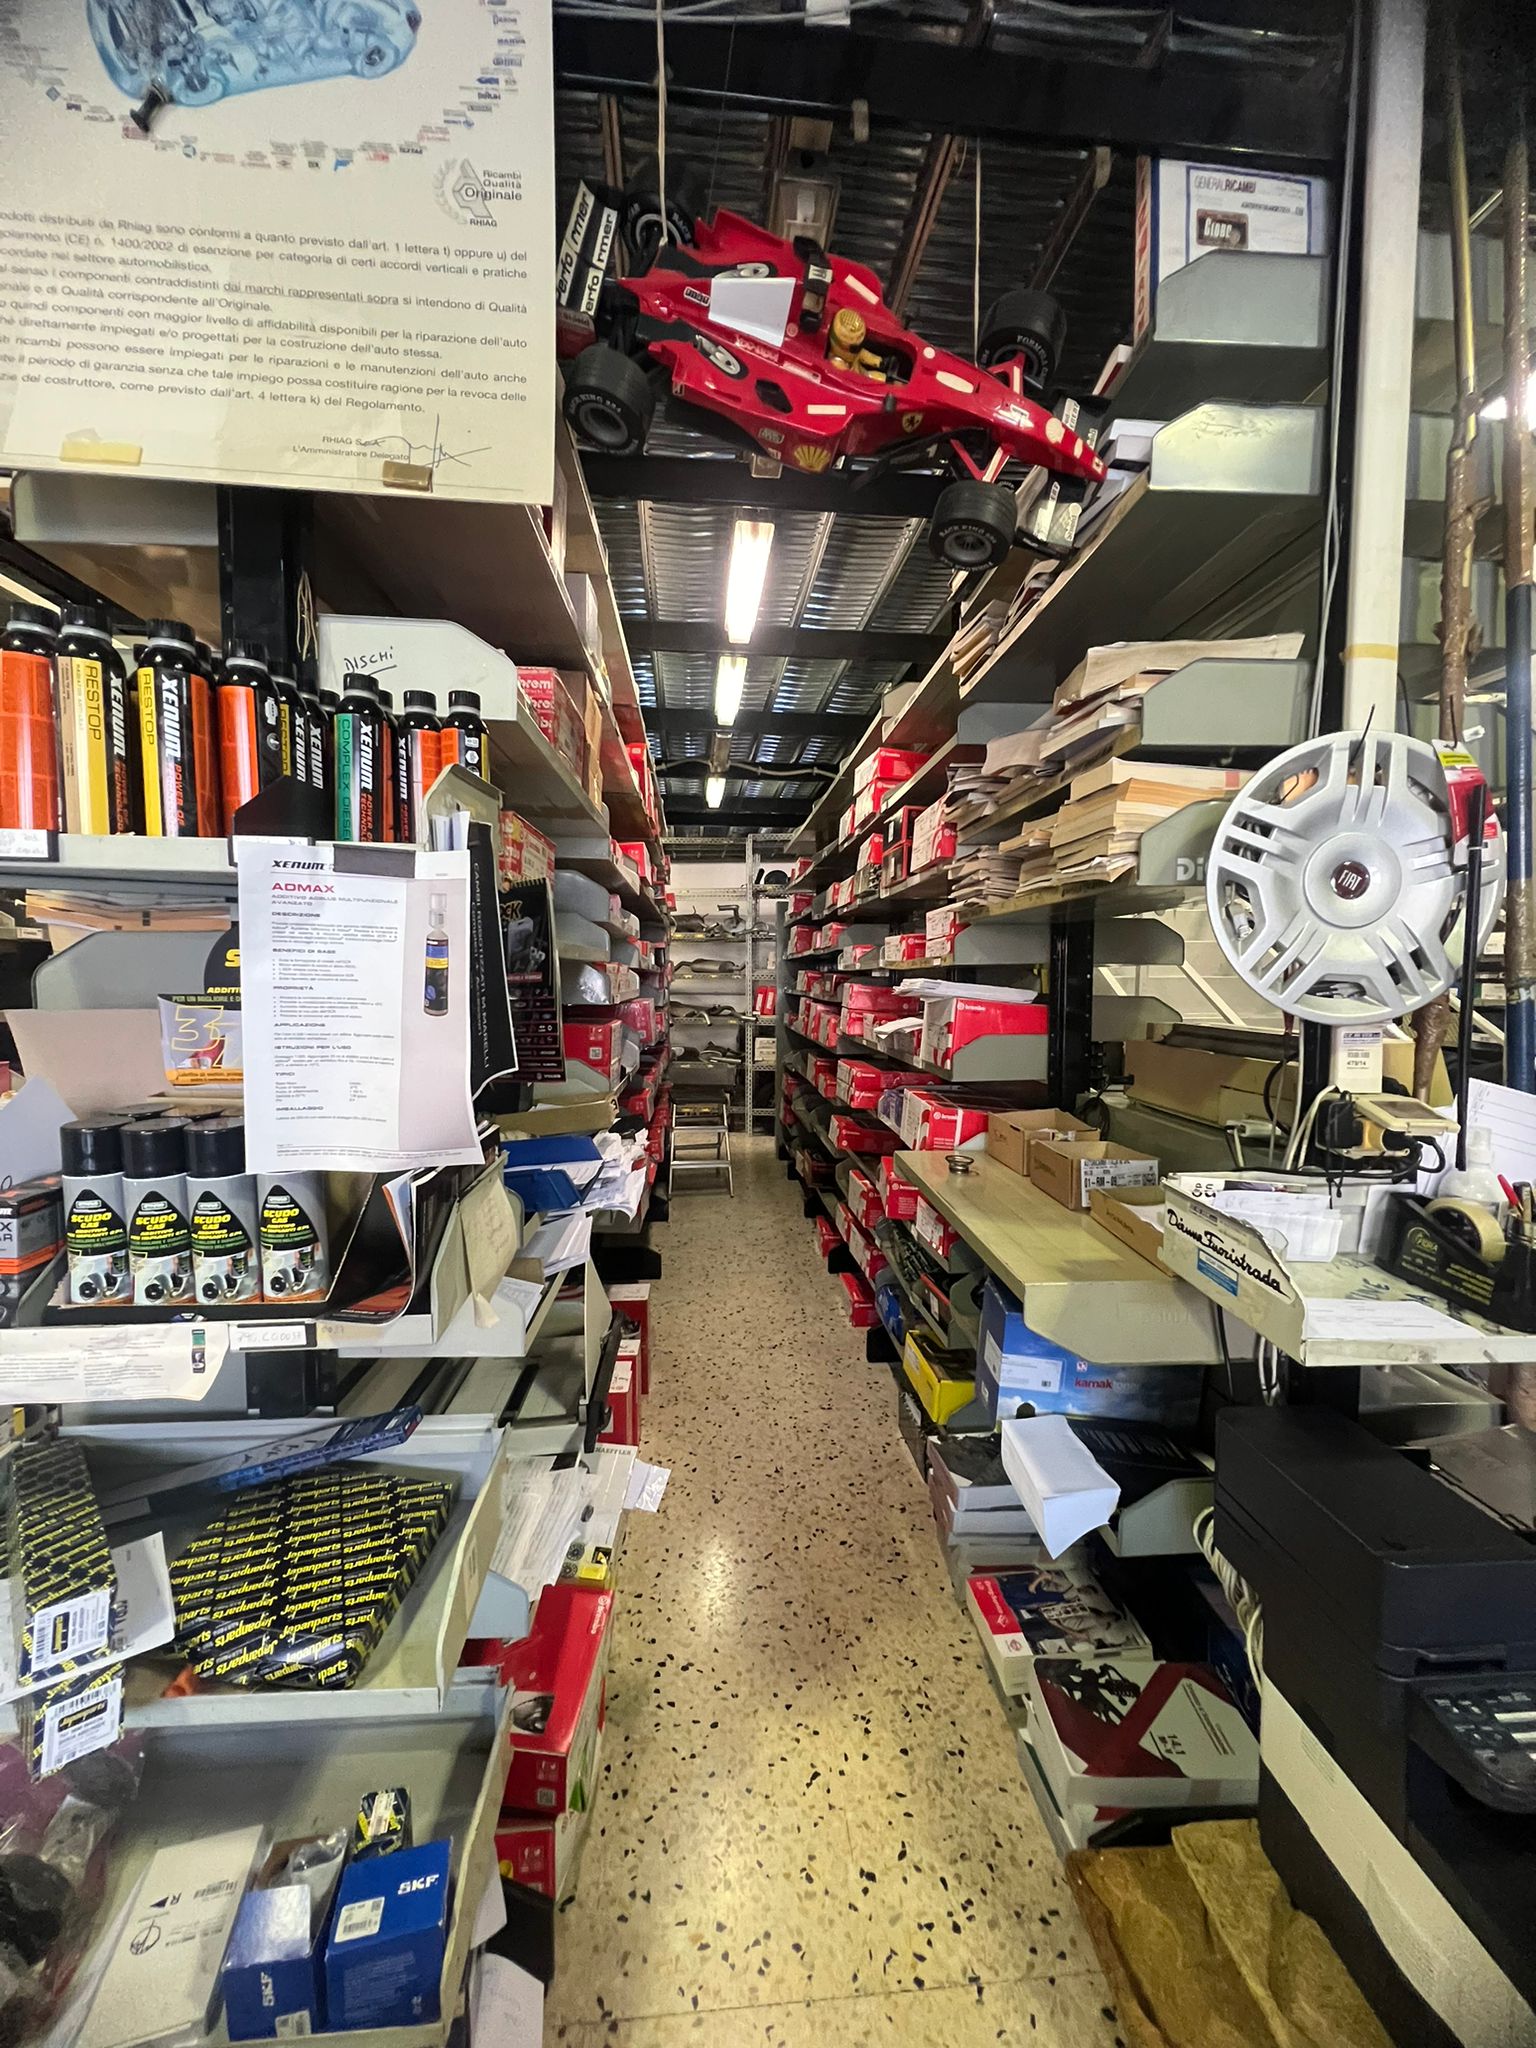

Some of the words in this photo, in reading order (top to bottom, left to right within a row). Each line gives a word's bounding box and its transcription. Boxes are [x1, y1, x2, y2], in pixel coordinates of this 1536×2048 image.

[483, 170, 521, 180] Ricambi
[483, 179, 521, 189] Qualità
[465, 187, 522, 201] Originale
[470, 218, 497, 227] RHIAG
[118, 220, 152, 235] Rhiag
[156, 226, 185, 235] sono
[190, 227, 240, 239] conformi
[256, 234, 295, 244] quanto
[300, 237, 344, 248] previsto
[348, 239, 389, 252] dall'art.
[405, 244, 440, 256] lettera
[455, 251, 493, 261] oppure
[74, 254, 116, 265] settore
[119, 257, 212, 272] automobilistico.
[111, 237, 174, 252] 1400/2002
[194, 247, 251, 259] esenzione
[279, 253, 332, 266] categoria
[380, 262, 422, 272] accordi
[426, 264, 468, 275] verticali
[483, 268, 527, 279] pratiche
[59, 271, 130, 283] componenti
[135, 276, 219, 290] contraddistinti
[245, 285, 284, 296] marchi
[288, 290, 363, 302] rappresentati
[367, 296, 398, 306] sopra
[416, 297, 471, 310] intendono
[488, 302, 527, 314] Qualità
[62, 285, 104, 298] Qualità
[108, 291, 198, 306] corrispondente
[202, 297, 272, 312] all'Originale.
[52, 305, 124, 316] componenti
[154, 312, 202, 323] maggior
[206, 314, 238, 326] livello
[257, 319, 316, 332] affidabilità
[320, 323, 376, 337] disponibili
[416, 331, 476, 345] riparazione
[480, 336, 527, 348] dell'auto
[100, 323, 155, 338] impiegati
[182, 332, 238, 343] progettati
[280, 339, 346, 352] costruzione
[351, 343, 399, 356] dell'auto
[403, 348, 442, 359] stessa.
[66, 342, 120, 352] possono
[125, 347, 164, 356] essere
[170, 348, 224, 362] impiegati
[269, 356, 329, 369] riparazioni
[360, 364, 436, 377] manutenzioni
[441, 369, 488, 381] dell'auto
[494, 374, 527, 384] anche
[28, 356, 75, 368] periodo
[94, 363, 144, 373] garanzia
[149, 367, 184, 376] senza
[237, 371, 283, 386] impiego
[287, 378, 322, 387] possa
[326, 379, 378, 391] costituire
[381, 384, 424, 395] ragione
[460, 391, 497, 400] revoca
[501, 391, 526, 402] delle
[45, 376, 115, 390] costruttore,
[120, 383, 154, 392] come
[159, 385, 206, 396] previsto
[210, 387, 252, 400] dall'art.
[270, 392, 306, 404] lettera
[346, 398, 424, 413] Regolamento.
[322, 436, 352, 444] RHIAG
[293, 446, 367, 457] L'Amministratore
[370, 451, 409, 460] Delegato
[85, 664, 102, 741] RESTOP
[143, 673, 154, 746] RESTOP
[110, 672, 126, 758] XENUM
[161, 674, 182, 758] XENUM
[310, 722, 324, 789] XENUM
[342, 718, 351, 792] COMPLEX
[360, 721, 373, 790] XENUM
[398, 737, 408, 799] XENUM
[272, 860, 325, 870] XENUM
[1176, 857, 1207, 881] Di
[272, 882, 335, 893] ADMAX
[1338, 871, 1362, 891] FIAT
[71, 1212, 112, 1223] SCUDO
[136, 1213, 178, 1225] SCUDO
[193, 1214, 231, 1224] SCUDO
[263, 1208, 300, 1218] SCUDO
[285, 1512, 341, 1530] Japanparts
[284, 1528, 341, 1546] Japanparts
[283, 1543, 341, 1562] Japanparts
[282, 1558, 342, 1579] Japanparts
[281, 1575, 342, 1598] Japanparts
[280, 1593, 342, 1618] Japanparts
[279, 1612, 342, 1642] Japanparts
[398, 1874, 440, 1895] SKF
[260, 1972, 275, 2007] SKF
